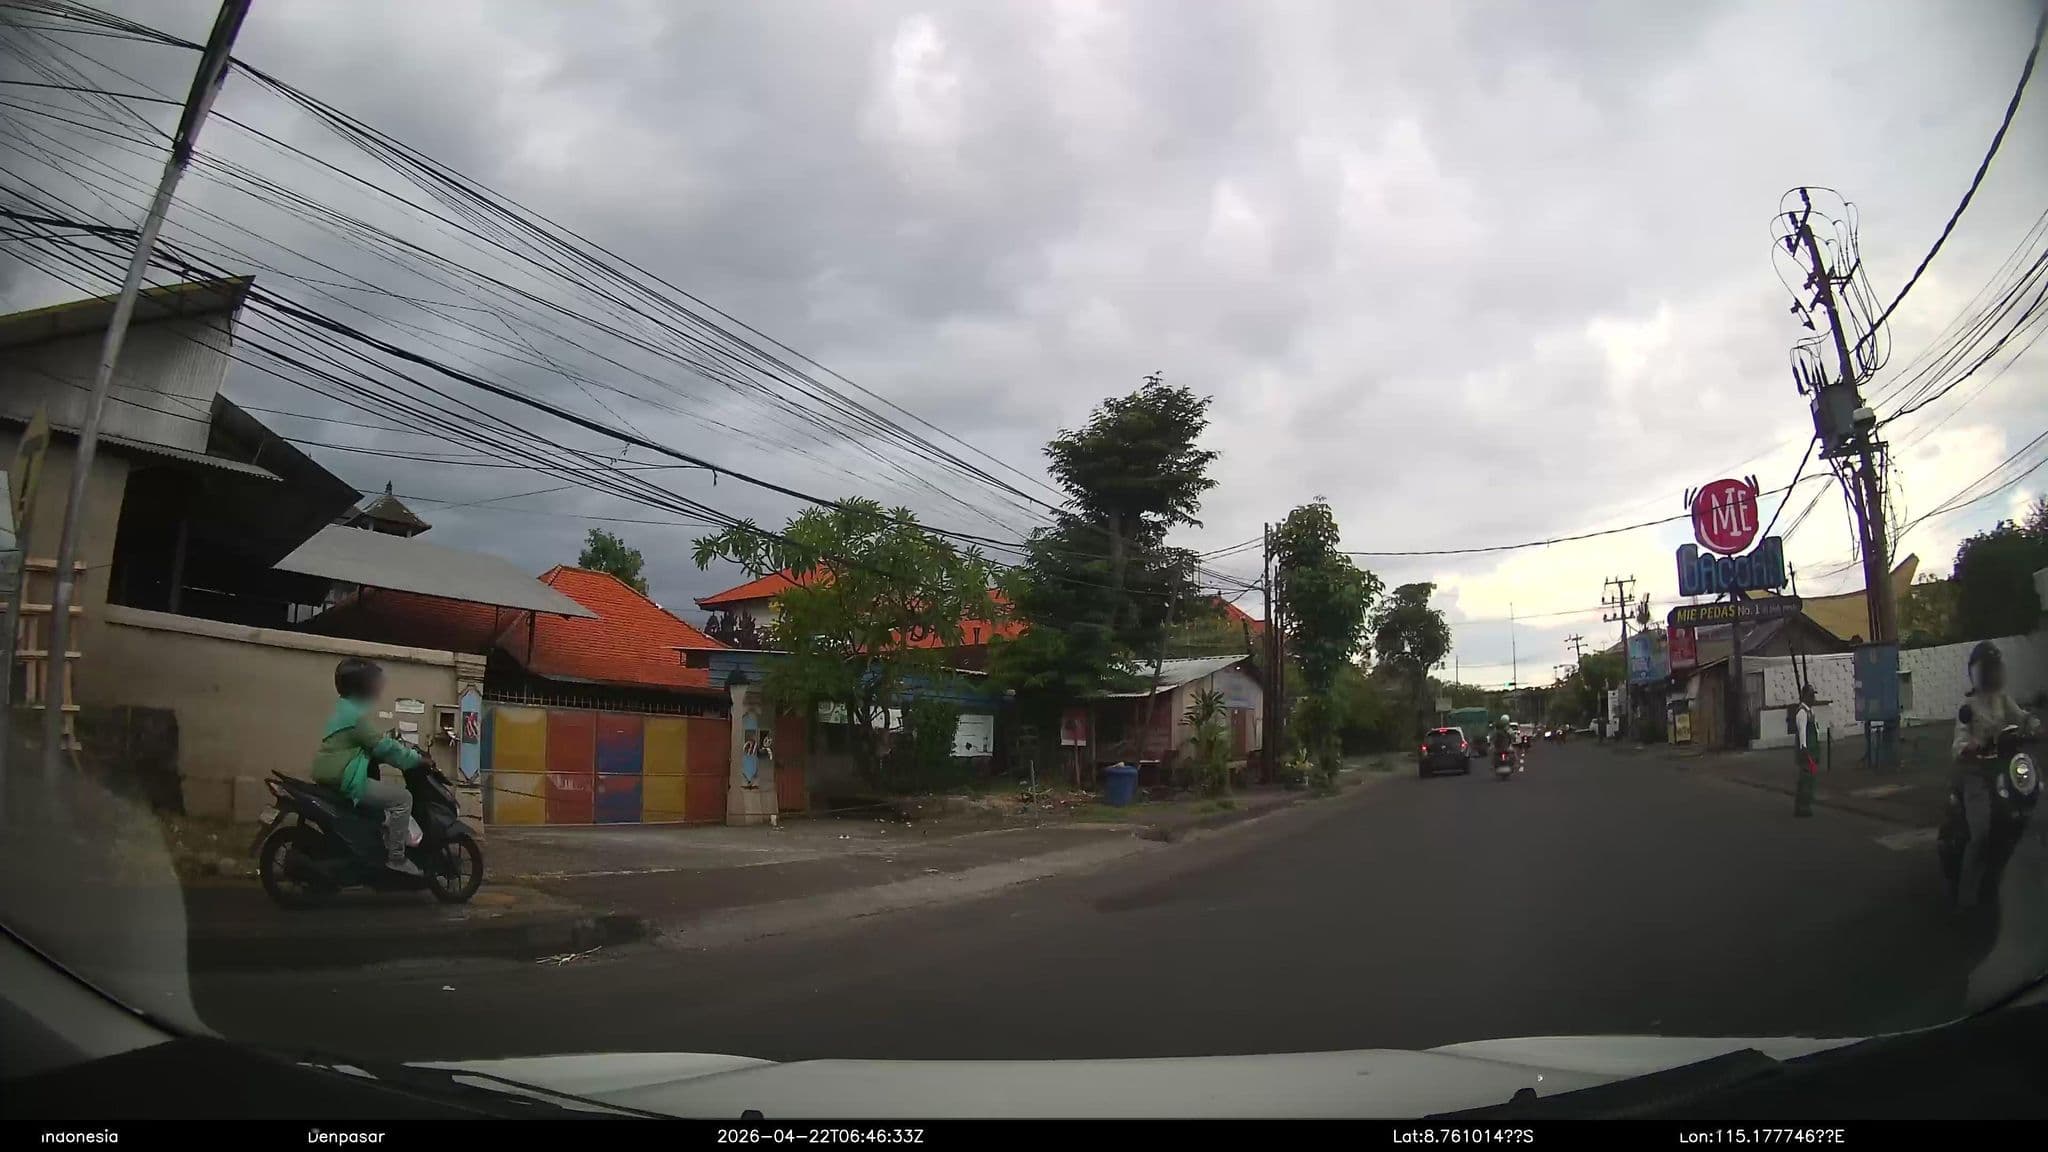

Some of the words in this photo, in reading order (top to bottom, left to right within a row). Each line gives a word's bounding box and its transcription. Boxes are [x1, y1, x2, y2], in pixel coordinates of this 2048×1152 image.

[1711, 487, 1752, 537] MIE
[1677, 608, 1697, 622] MIE
[1700, 604, 1736, 619] PEDAS
